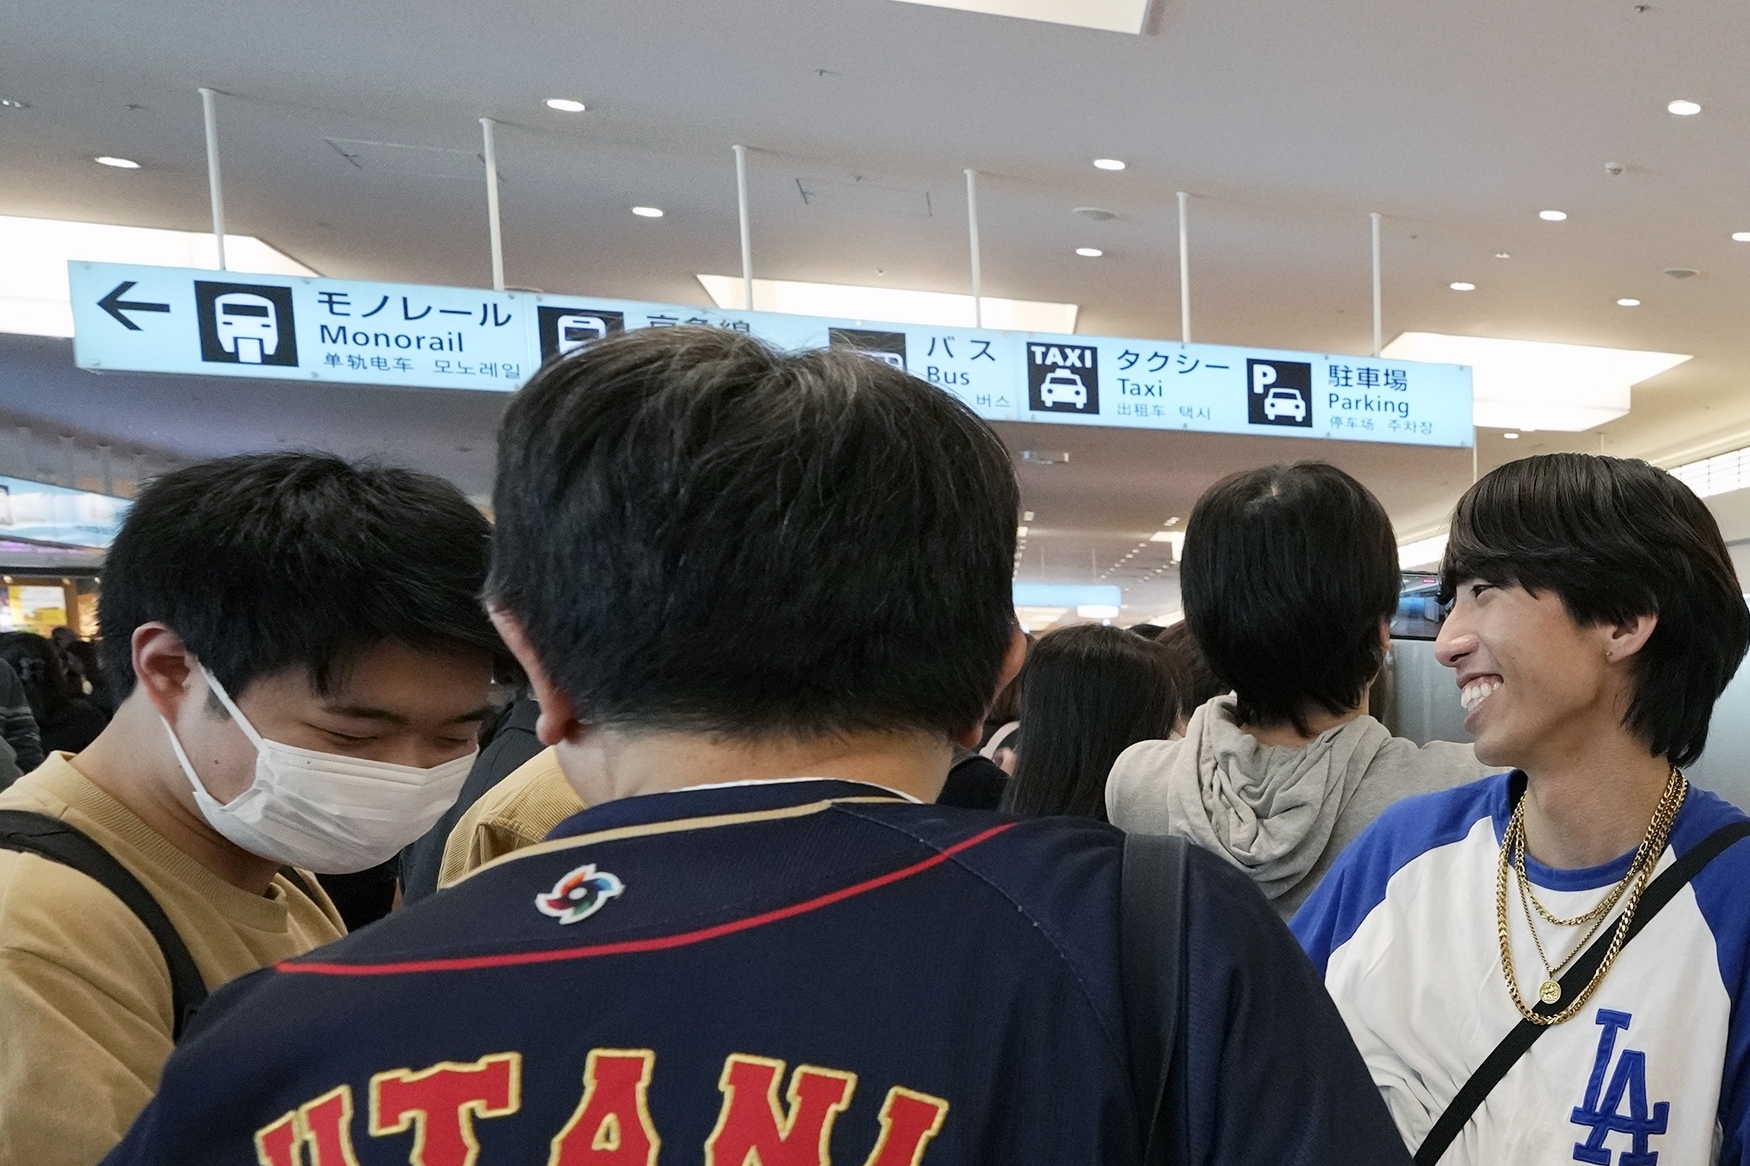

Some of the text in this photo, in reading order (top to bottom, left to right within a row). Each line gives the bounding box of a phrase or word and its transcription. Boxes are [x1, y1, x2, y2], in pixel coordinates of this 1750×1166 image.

[317, 291, 512, 327] モノレール
[320, 324, 464, 353] Monorail
[927, 335, 996, 362] バス
[323, 352, 414, 373] 单轨电车
[1030, 345, 1093, 368] TAXI
[1117, 349, 1230, 374] タクシー
[433, 359, 520, 379] 모노레일
[927, 366, 970, 385] Bus
[1328, 364, 1408, 392] 駐車場
[1117, 378, 1163, 397] Taxi
[976, 394, 1011, 409] 버스
[1328, 393, 1409, 419] Parking
